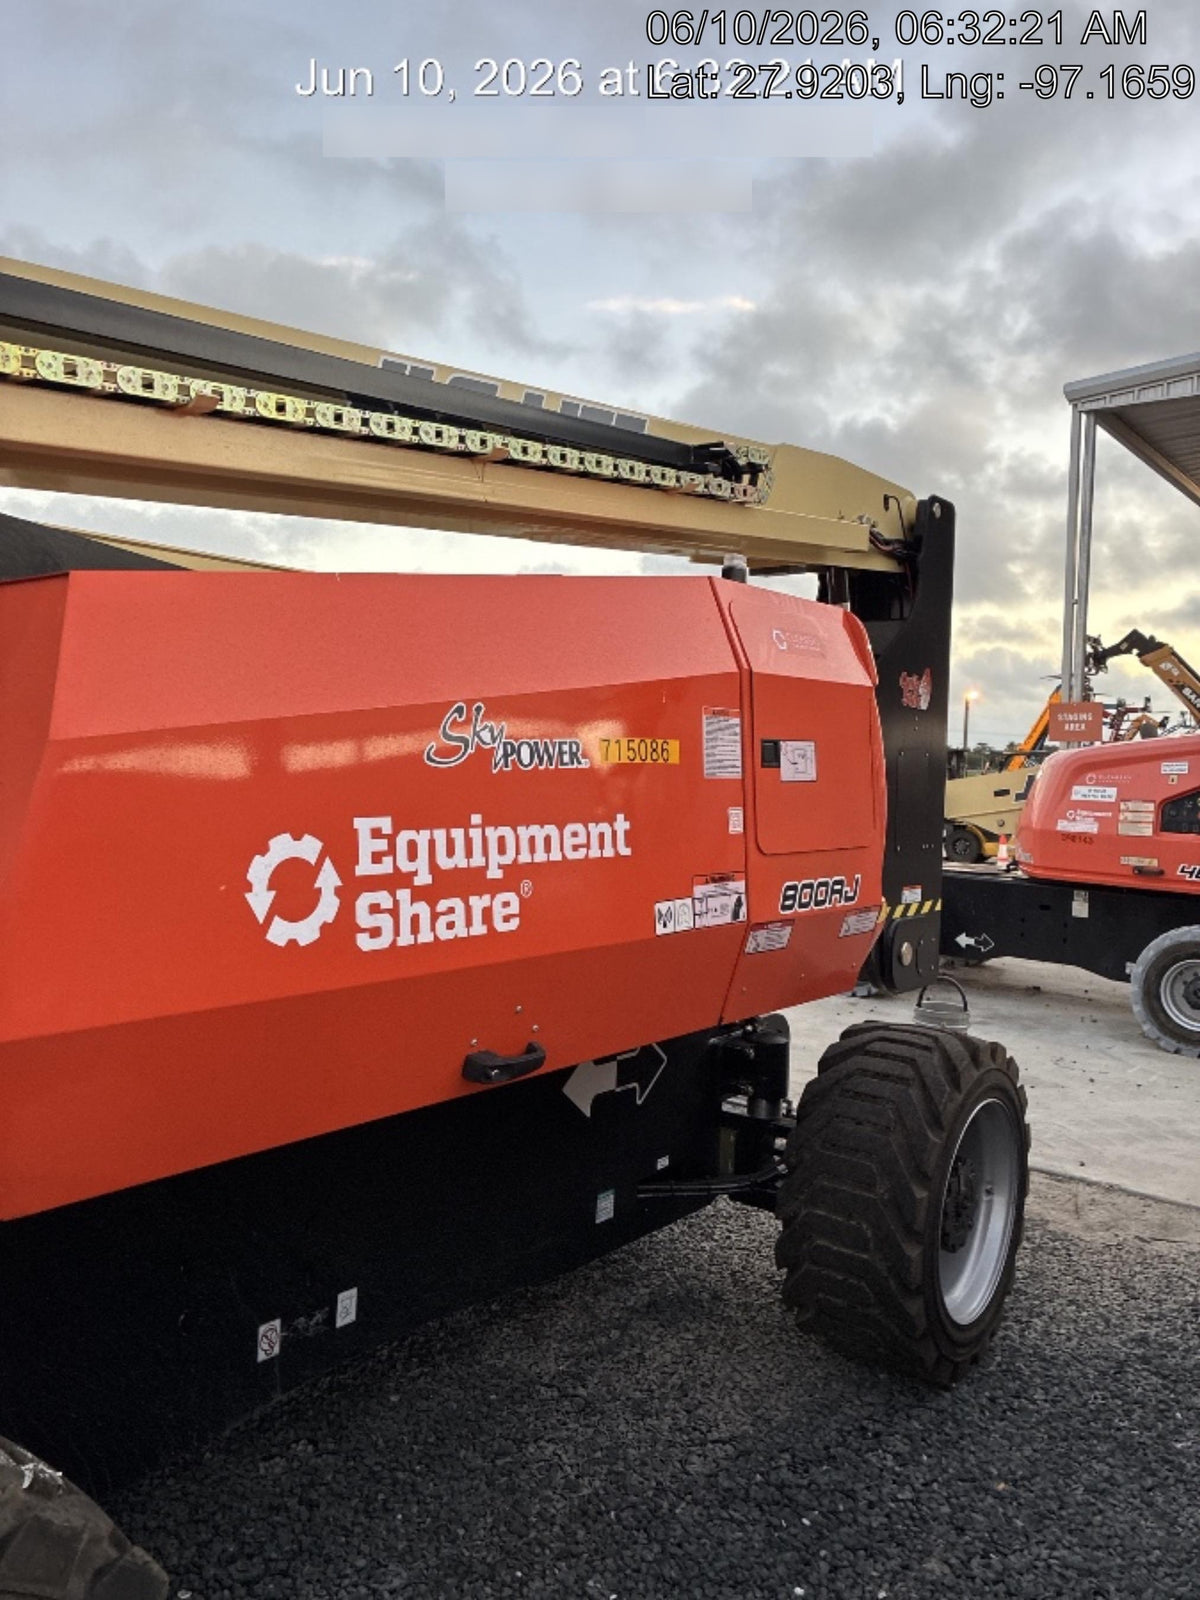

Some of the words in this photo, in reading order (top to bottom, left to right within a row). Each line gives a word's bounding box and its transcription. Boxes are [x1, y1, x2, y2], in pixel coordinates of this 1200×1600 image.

[424, 702, 505, 774] Sky
[500, 738, 584, 770] POWER
[601, 738, 671, 763] 715086
[353, 812, 633, 887] Equipment
[778, 874, 861, 914] 800AJ
